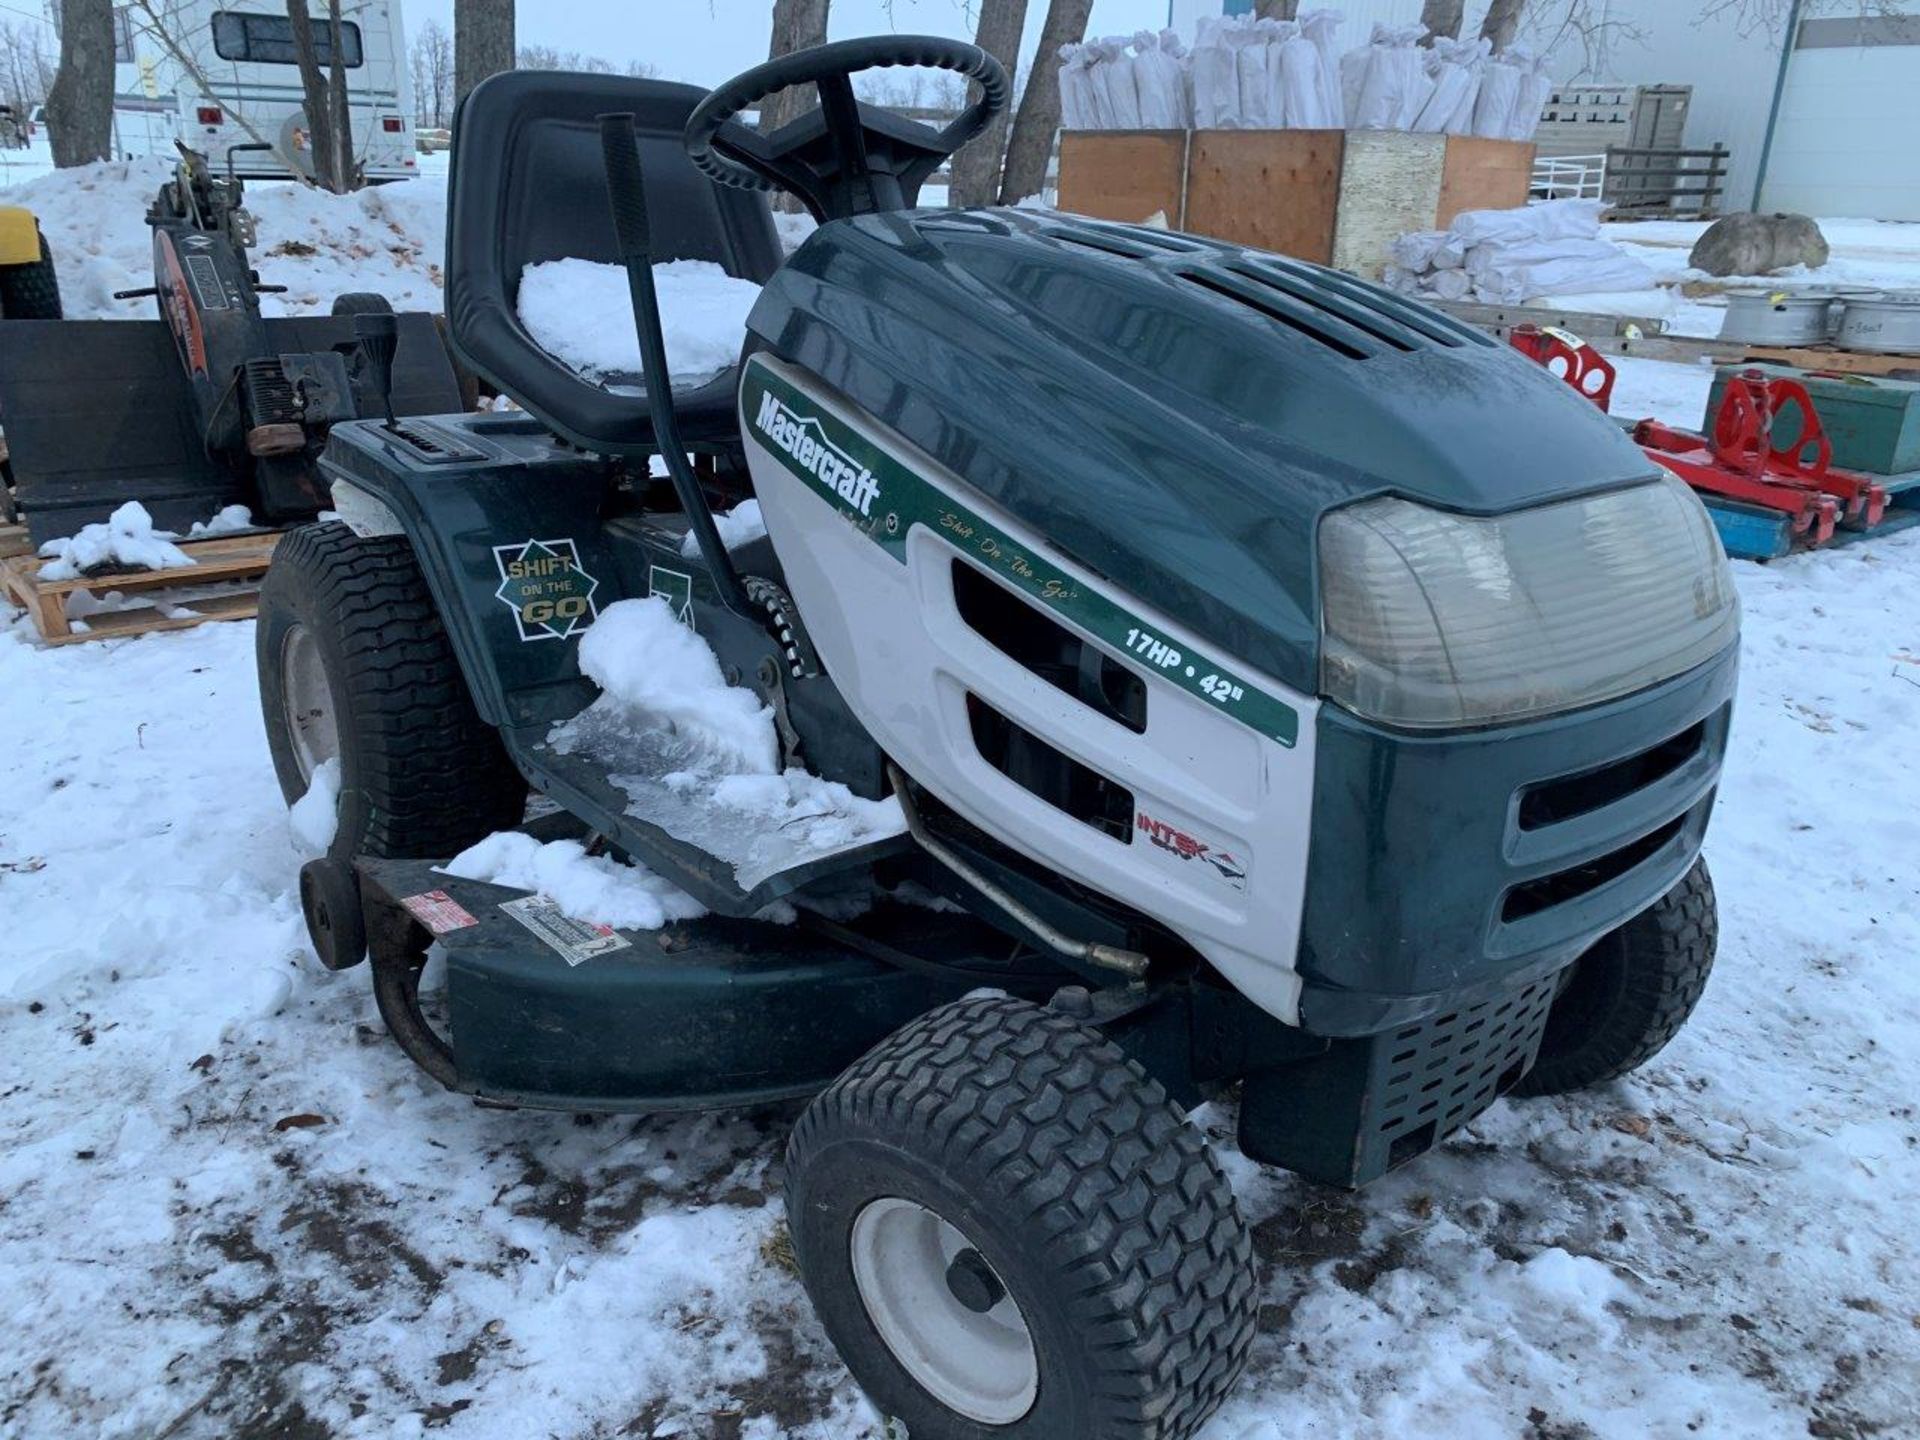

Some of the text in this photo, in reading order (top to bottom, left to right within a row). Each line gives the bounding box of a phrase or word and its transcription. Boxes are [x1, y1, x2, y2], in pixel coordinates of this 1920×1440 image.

[755, 389, 881, 517] Mastercraft
[508, 555, 572, 579] SHIFT
[521, 580, 573, 596] ON THE
[522, 596, 587, 624] GO
[1125, 628, 1244, 703] 17HP 42"
[1136, 812, 1210, 863] INTEK
